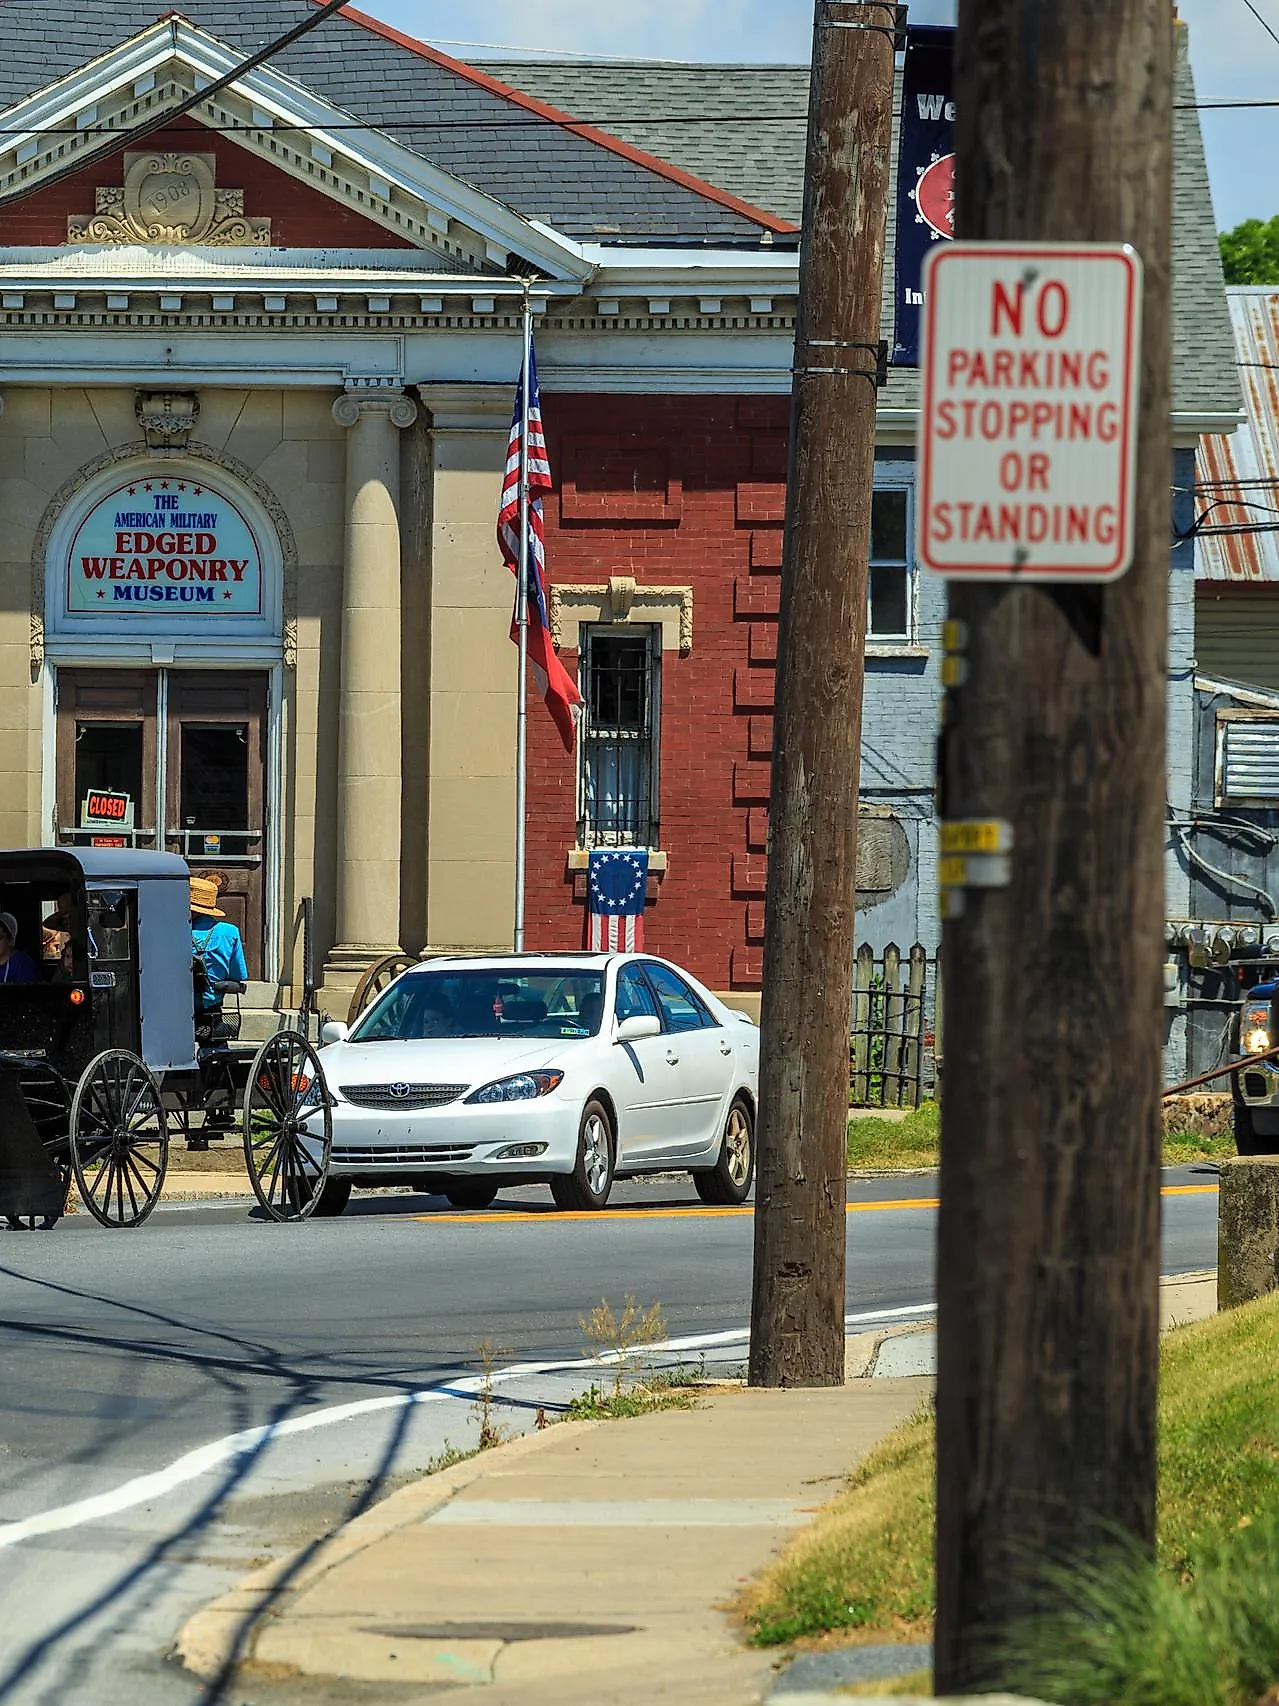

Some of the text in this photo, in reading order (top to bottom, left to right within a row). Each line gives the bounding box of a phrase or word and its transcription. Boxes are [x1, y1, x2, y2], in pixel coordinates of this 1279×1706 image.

[991, 279, 1070, 339] NO
[947, 350, 1109, 391] PARKING
[934, 401, 1119, 443] STOPPING
[999, 451, 1051, 493] OR
[153, 495, 179, 510] THE
[114, 513, 218, 529] AMERICAN MILITARY
[931, 503, 1118, 545] STANDING
[115, 532, 217, 555] EDGED
[81, 557, 249, 581] WEAPONRY
[113, 585, 215, 601] MUSEUM
[90, 796, 125, 817] CLOSED
